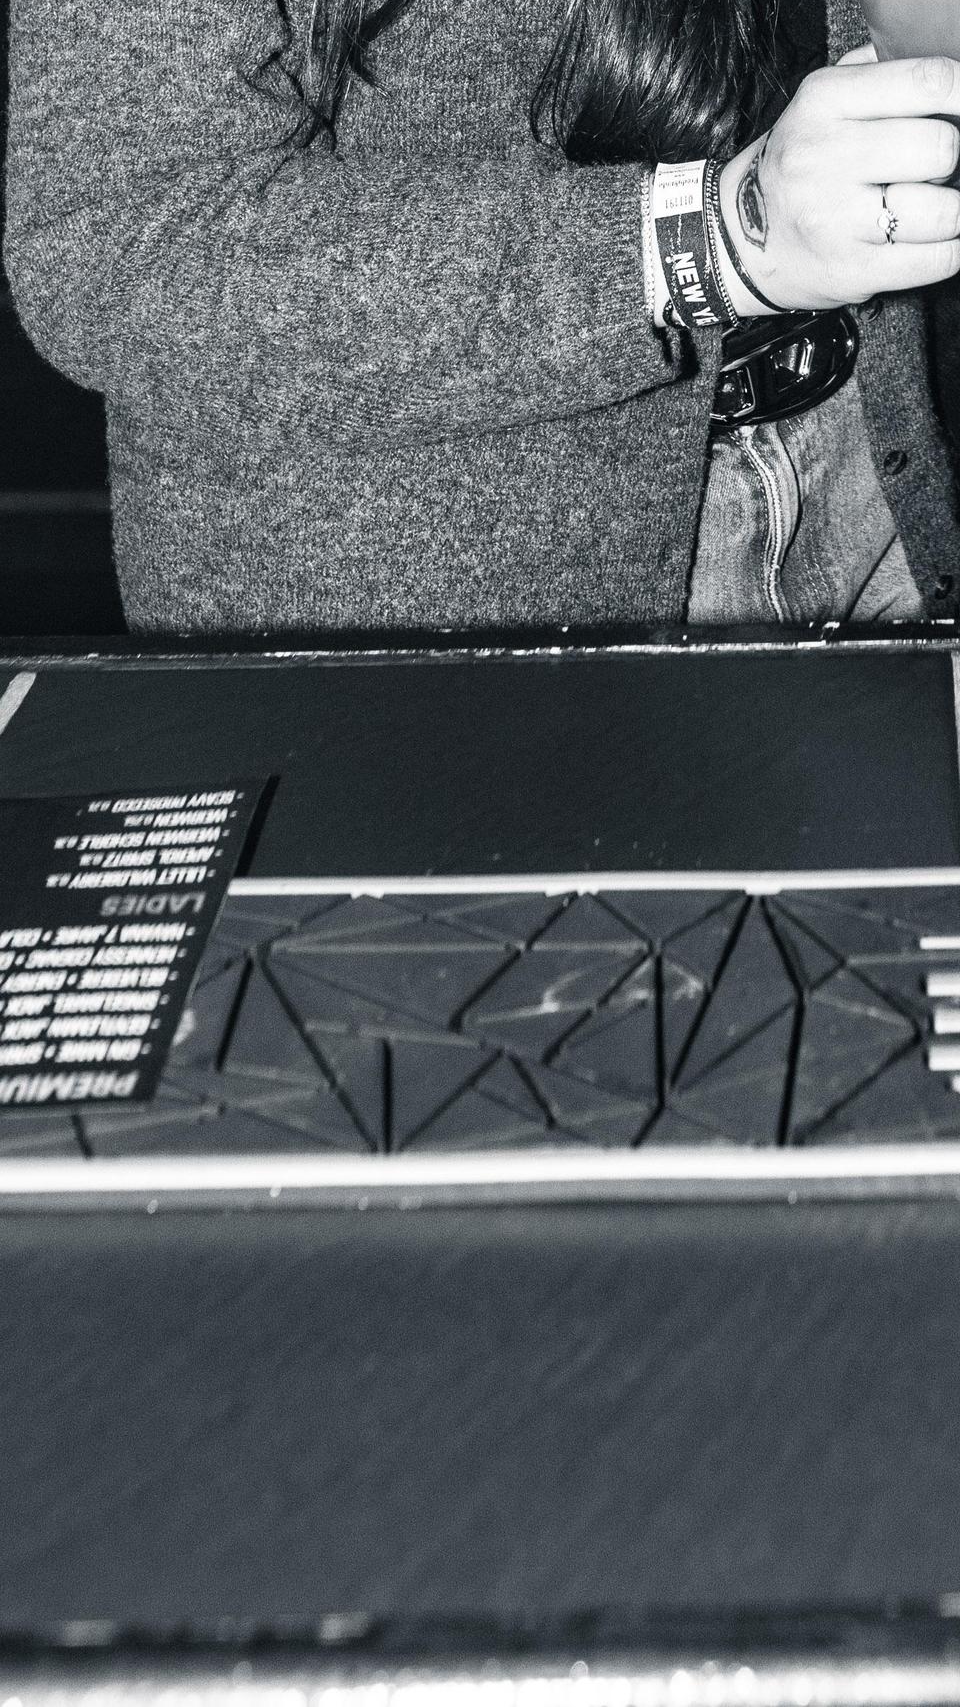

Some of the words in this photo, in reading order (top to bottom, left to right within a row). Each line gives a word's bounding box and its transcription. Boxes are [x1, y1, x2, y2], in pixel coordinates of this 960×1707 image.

[673, 252, 707, 303] NEW
[155, 865, 208, 886] LILLET
[100, 892, 206, 917] LADIES
